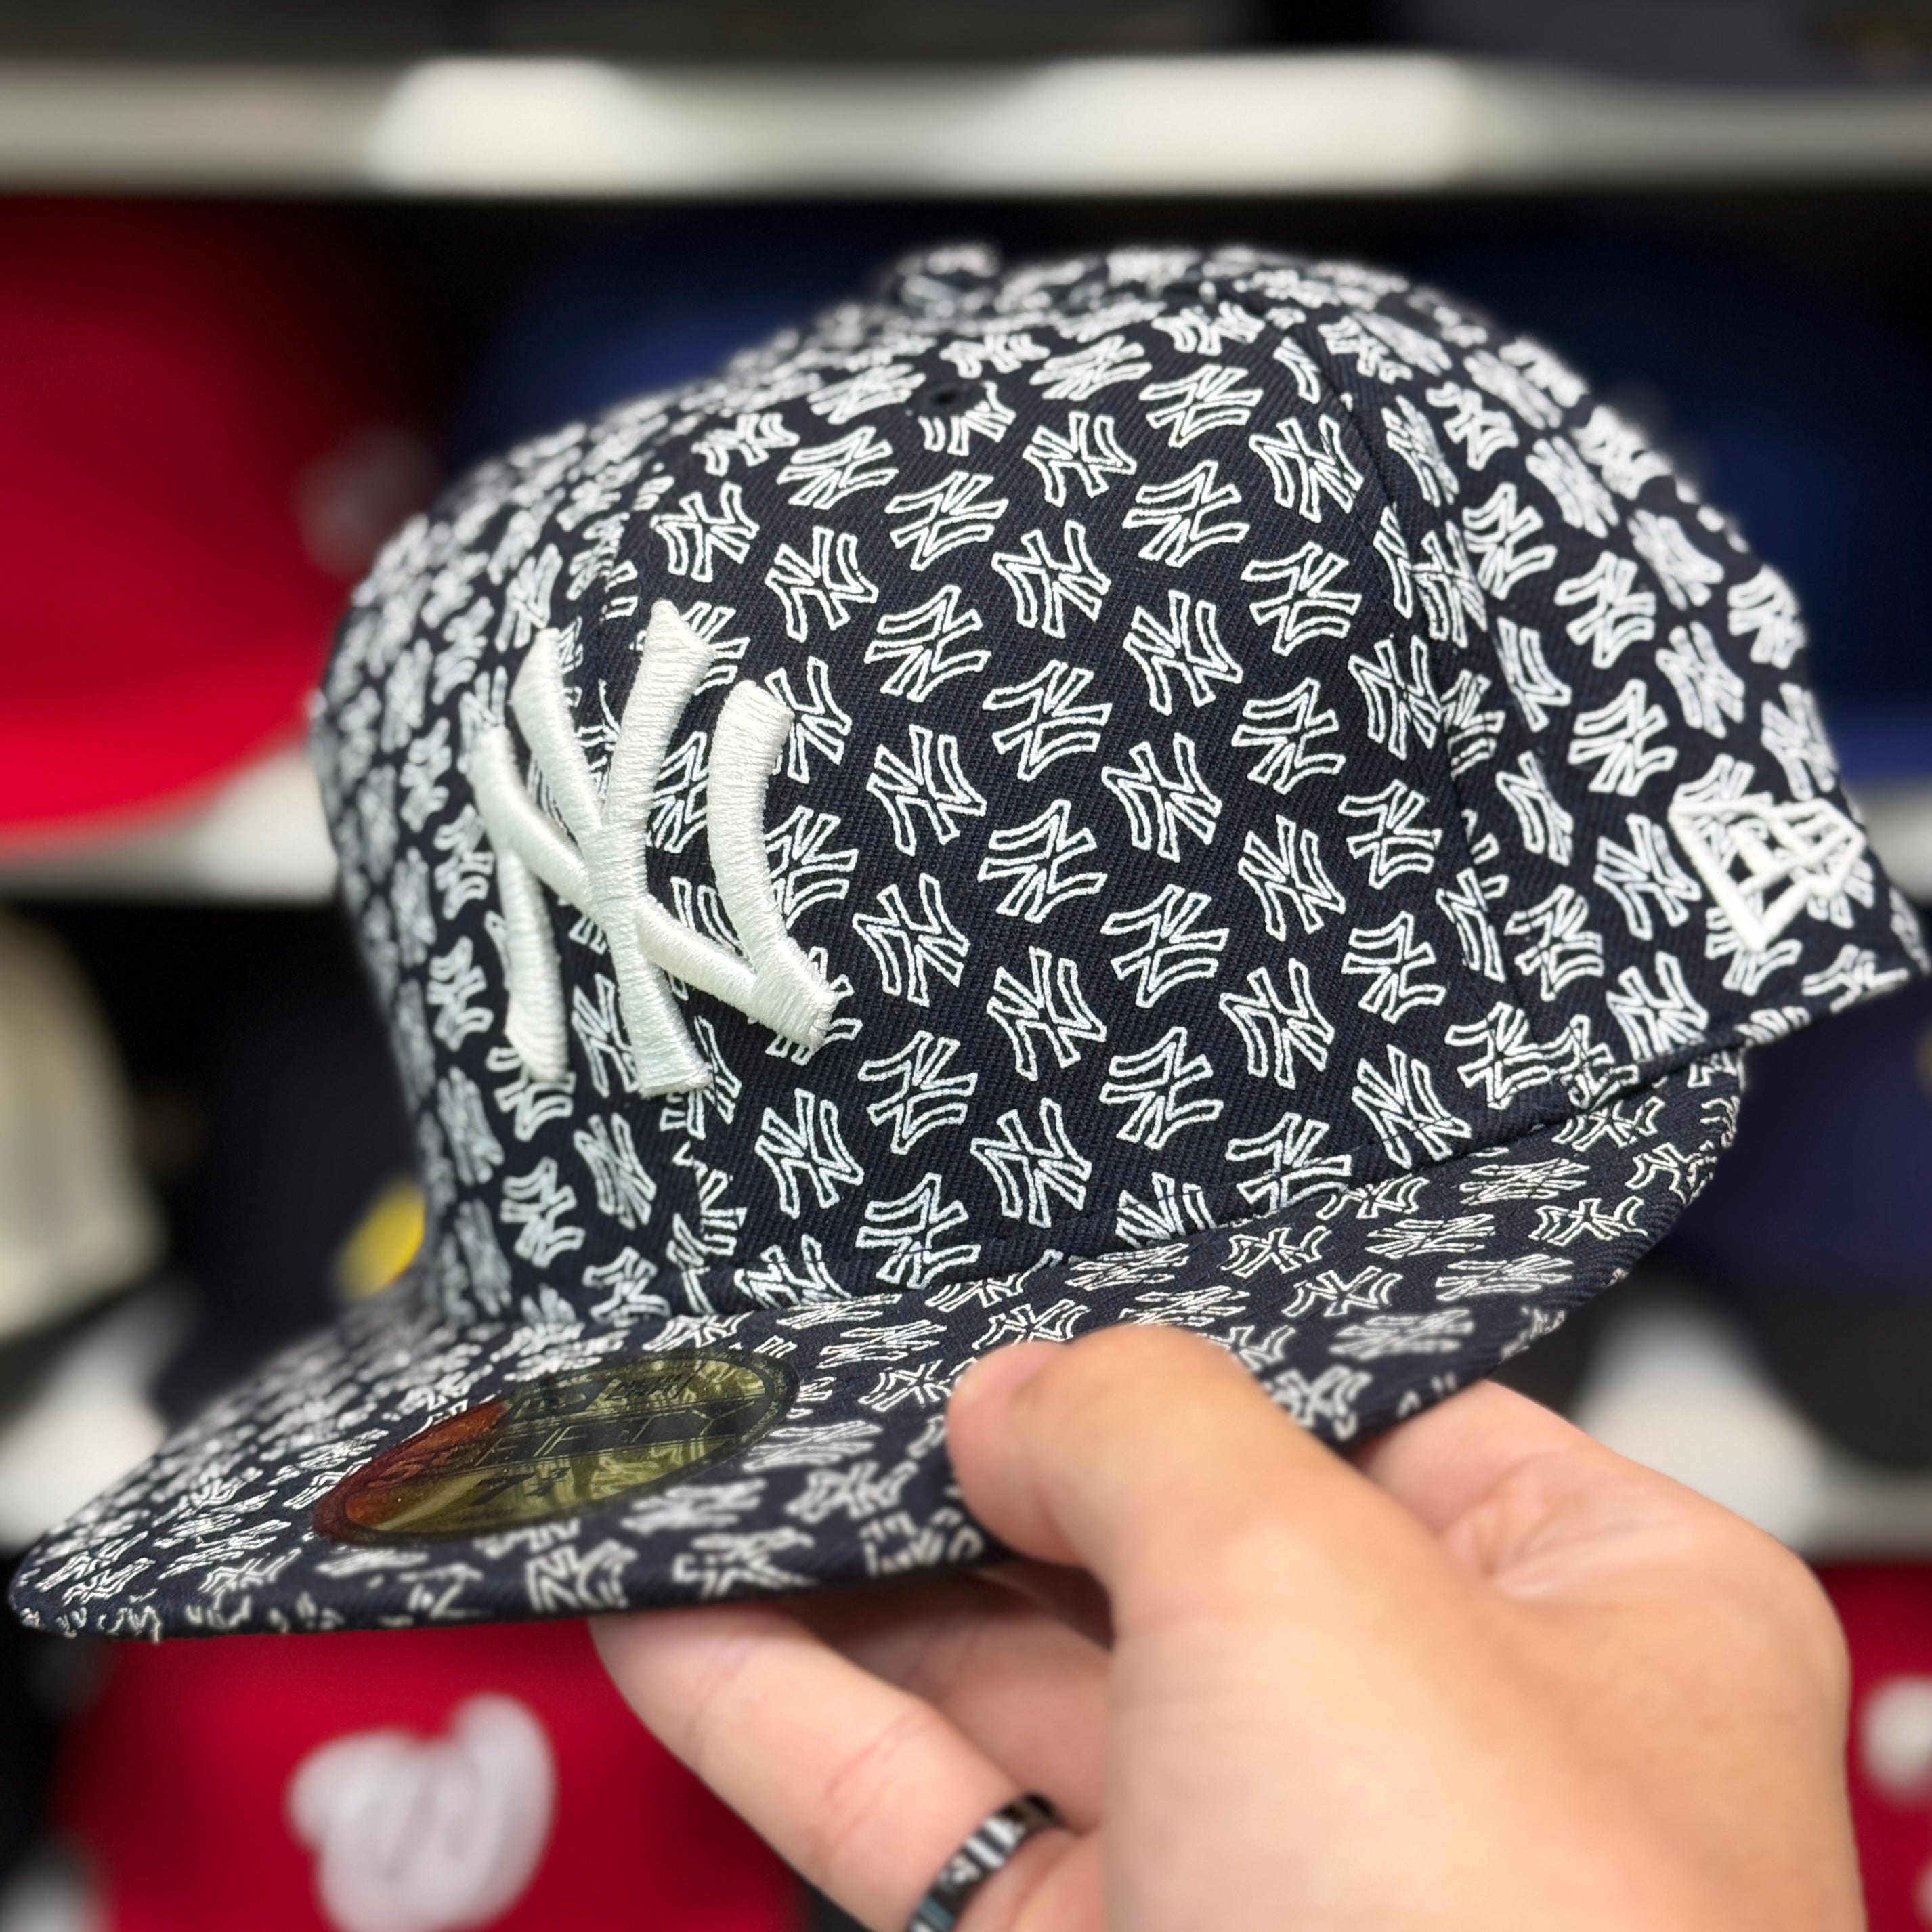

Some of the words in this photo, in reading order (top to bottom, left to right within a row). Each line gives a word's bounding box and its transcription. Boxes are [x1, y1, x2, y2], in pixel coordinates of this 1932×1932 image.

[777, 426, 899, 510] NY
[1022, 410, 1138, 508] NY
[1138, 363, 1264, 449] NY
[1248, 413, 1365, 523] NY
[653, 483, 759, 582] NY
[884, 469, 1009, 571] NY
[1121, 459, 1251, 568] NY
[1463, 482, 1557, 601] NY
[764, 525, 879, 643] NY
[991, 513, 1111, 639] NY
[1241, 540, 1362, 656] NY
[1553, 550, 1656, 669] NY
[863, 584, 992, 703] NY
[1122, 588, 1244, 716] NY
[1348, 635, 1441, 760] NY
[982, 658, 1113, 782] NY
[1231, 677, 1346, 795] NY
[1568, 679, 1678, 797] NY
[467, 600, 839, 1097] NY
[866, 723, 987, 857] NY
[1101, 732, 1223, 863] NY
[1338, 779, 1443, 890] NY
[977, 798, 1108, 924] NY
[1238, 814, 1346, 942] NY
[1594, 814, 1701, 940] NY
[852, 872, 971, 1008] NY
[1100, 884, 1230, 1008] NY
[1341, 910, 1447, 1024] NY
[987, 945, 1107, 1081] NY
[1218, 958, 1335, 1090] NY
[857, 1030, 978, 1155] NY
[1099, 1026, 1224, 1150] NY
[1351, 1044, 1472, 1169] NY
[500, 1157, 585, 1268] NY
[754, 1088, 865, 1219] NY
[970, 1097, 1092, 1228] NY
[855, 1173, 981, 1289] NY
